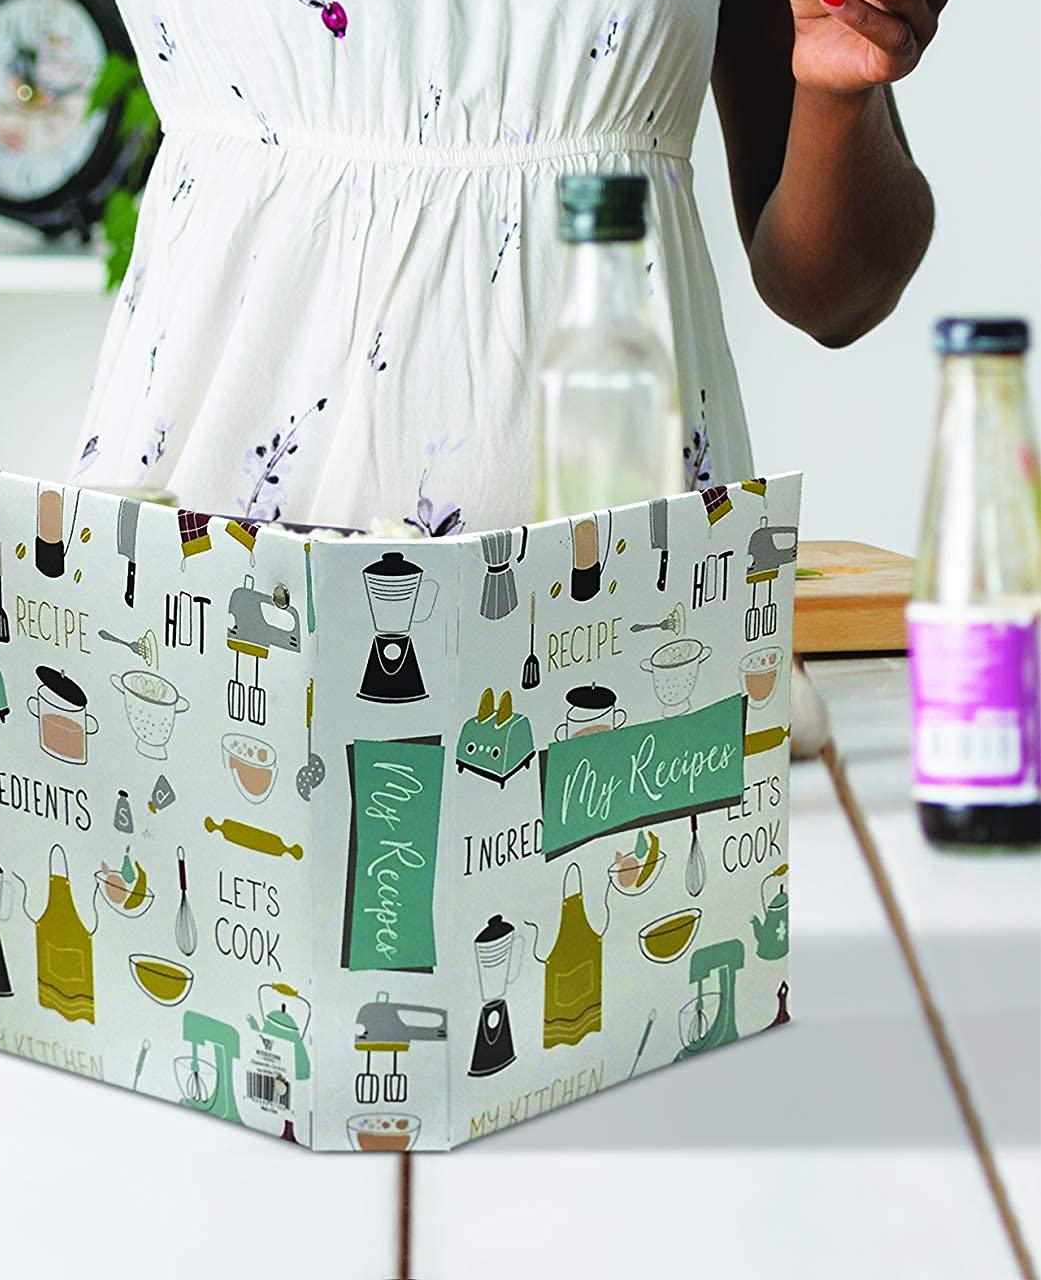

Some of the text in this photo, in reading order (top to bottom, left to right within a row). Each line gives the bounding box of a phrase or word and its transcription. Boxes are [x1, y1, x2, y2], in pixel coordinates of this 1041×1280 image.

[692, 551, 735, 609] HOT
[17, 595, 91, 654] RECIPE
[165, 591, 212, 654] HOT
[548, 617, 624, 672] RECIPE
[562, 734, 736, 824] My Recipes
[119, 808, 129, 827] S
[723, 820, 781, 872] COOK
[364, 762, 426, 960] My Recipes
[464, 819, 544, 876] INGRED
[219, 871, 280, 917] LET'S
[215, 917, 282, 971] COOK
[469, 1060, 605, 1140] MY KITCHEN
